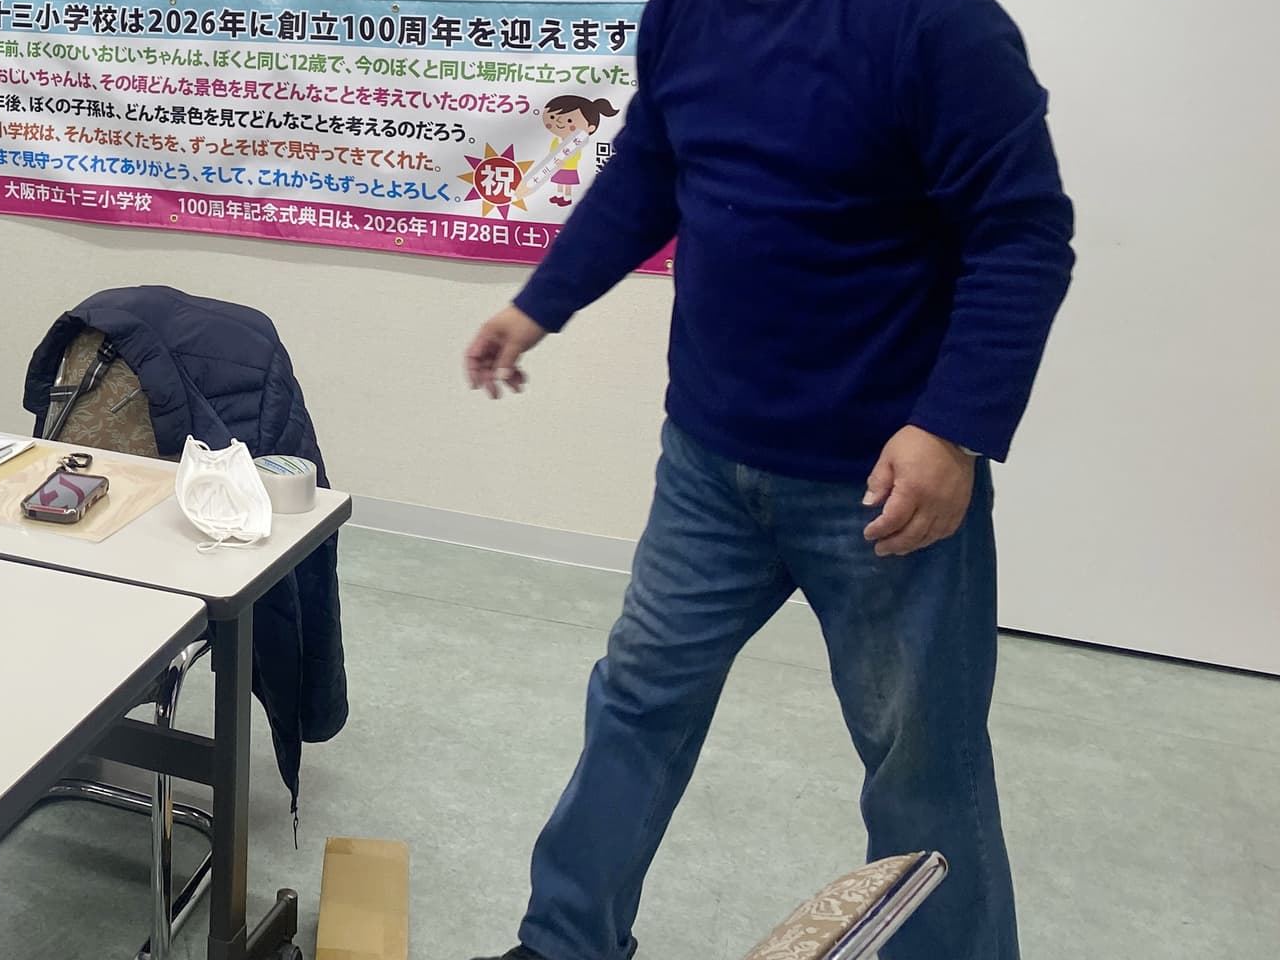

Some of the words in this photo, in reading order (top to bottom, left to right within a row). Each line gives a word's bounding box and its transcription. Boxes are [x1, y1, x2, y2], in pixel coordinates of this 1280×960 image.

[480, 164, 516, 202] 祝
[4, 181, 153, 212] 大阪市立十三小学校
[178, 197, 560, 249] 100周年記念式典日は、2026年11月28日（土）
